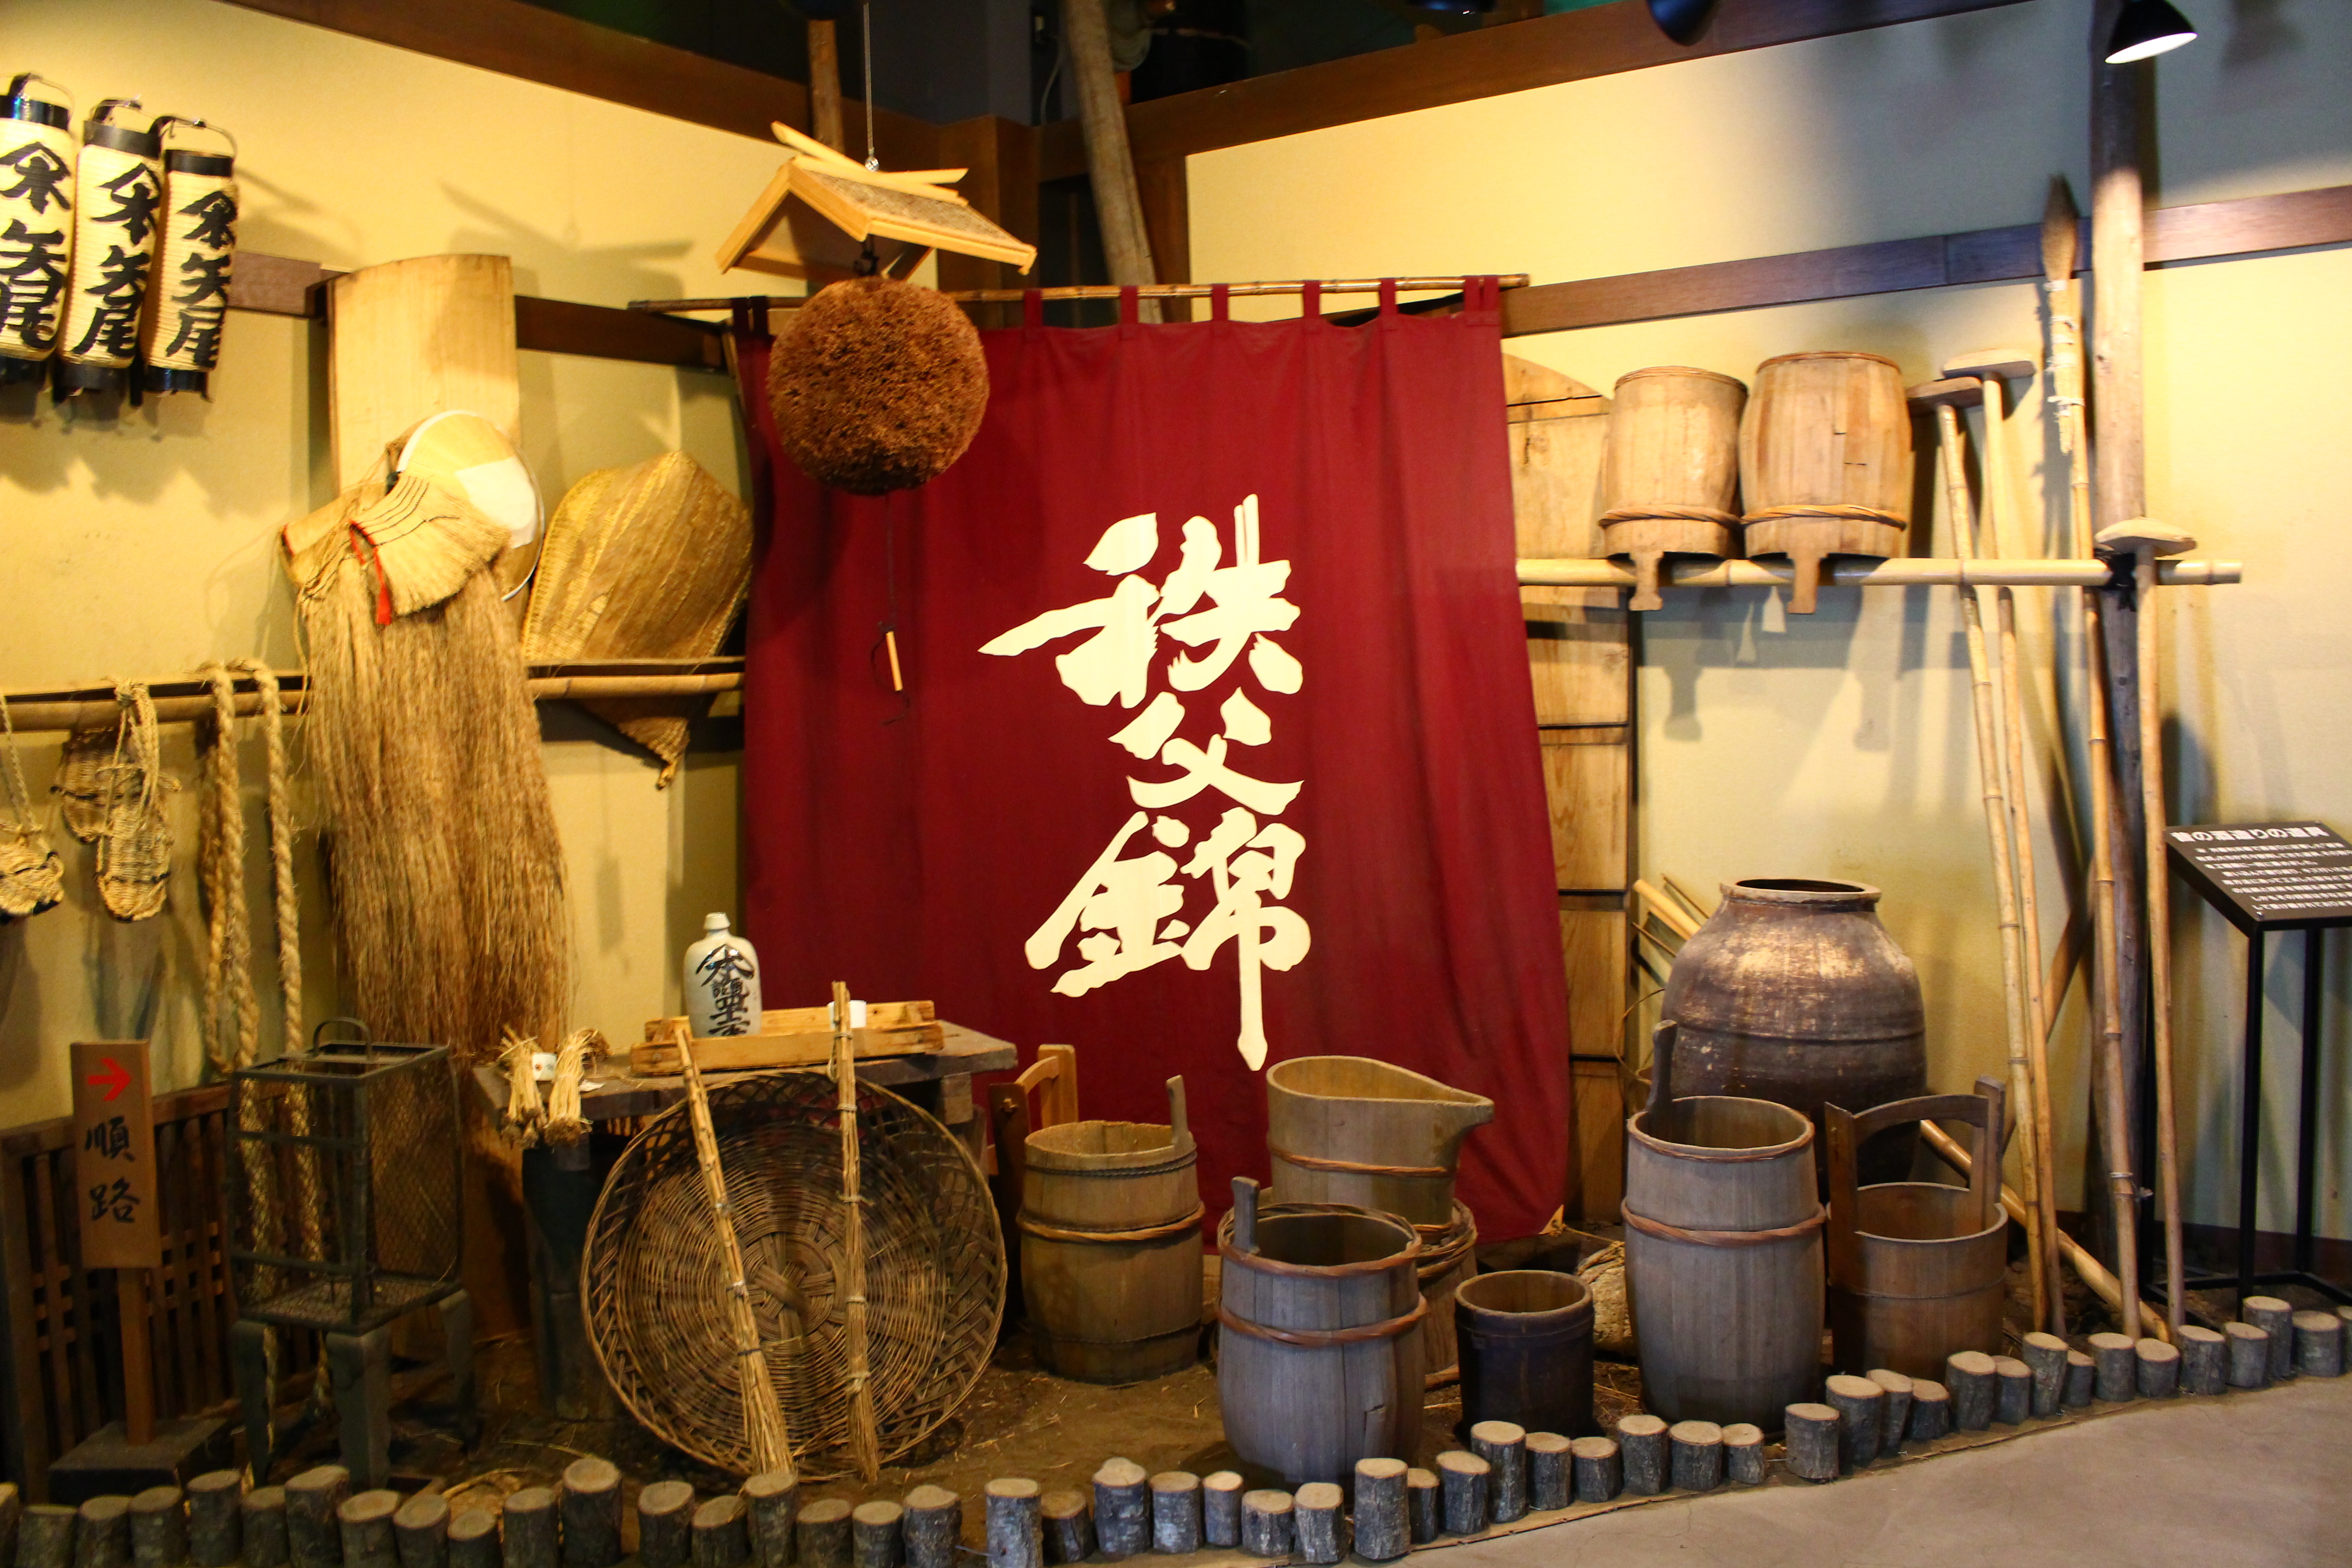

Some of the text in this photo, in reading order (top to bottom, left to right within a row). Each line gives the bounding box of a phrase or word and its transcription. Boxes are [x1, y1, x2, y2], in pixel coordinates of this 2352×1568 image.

[977, 493, 1311, 1071] 秩父錦
[84, 1116, 140, 1224] 順路
